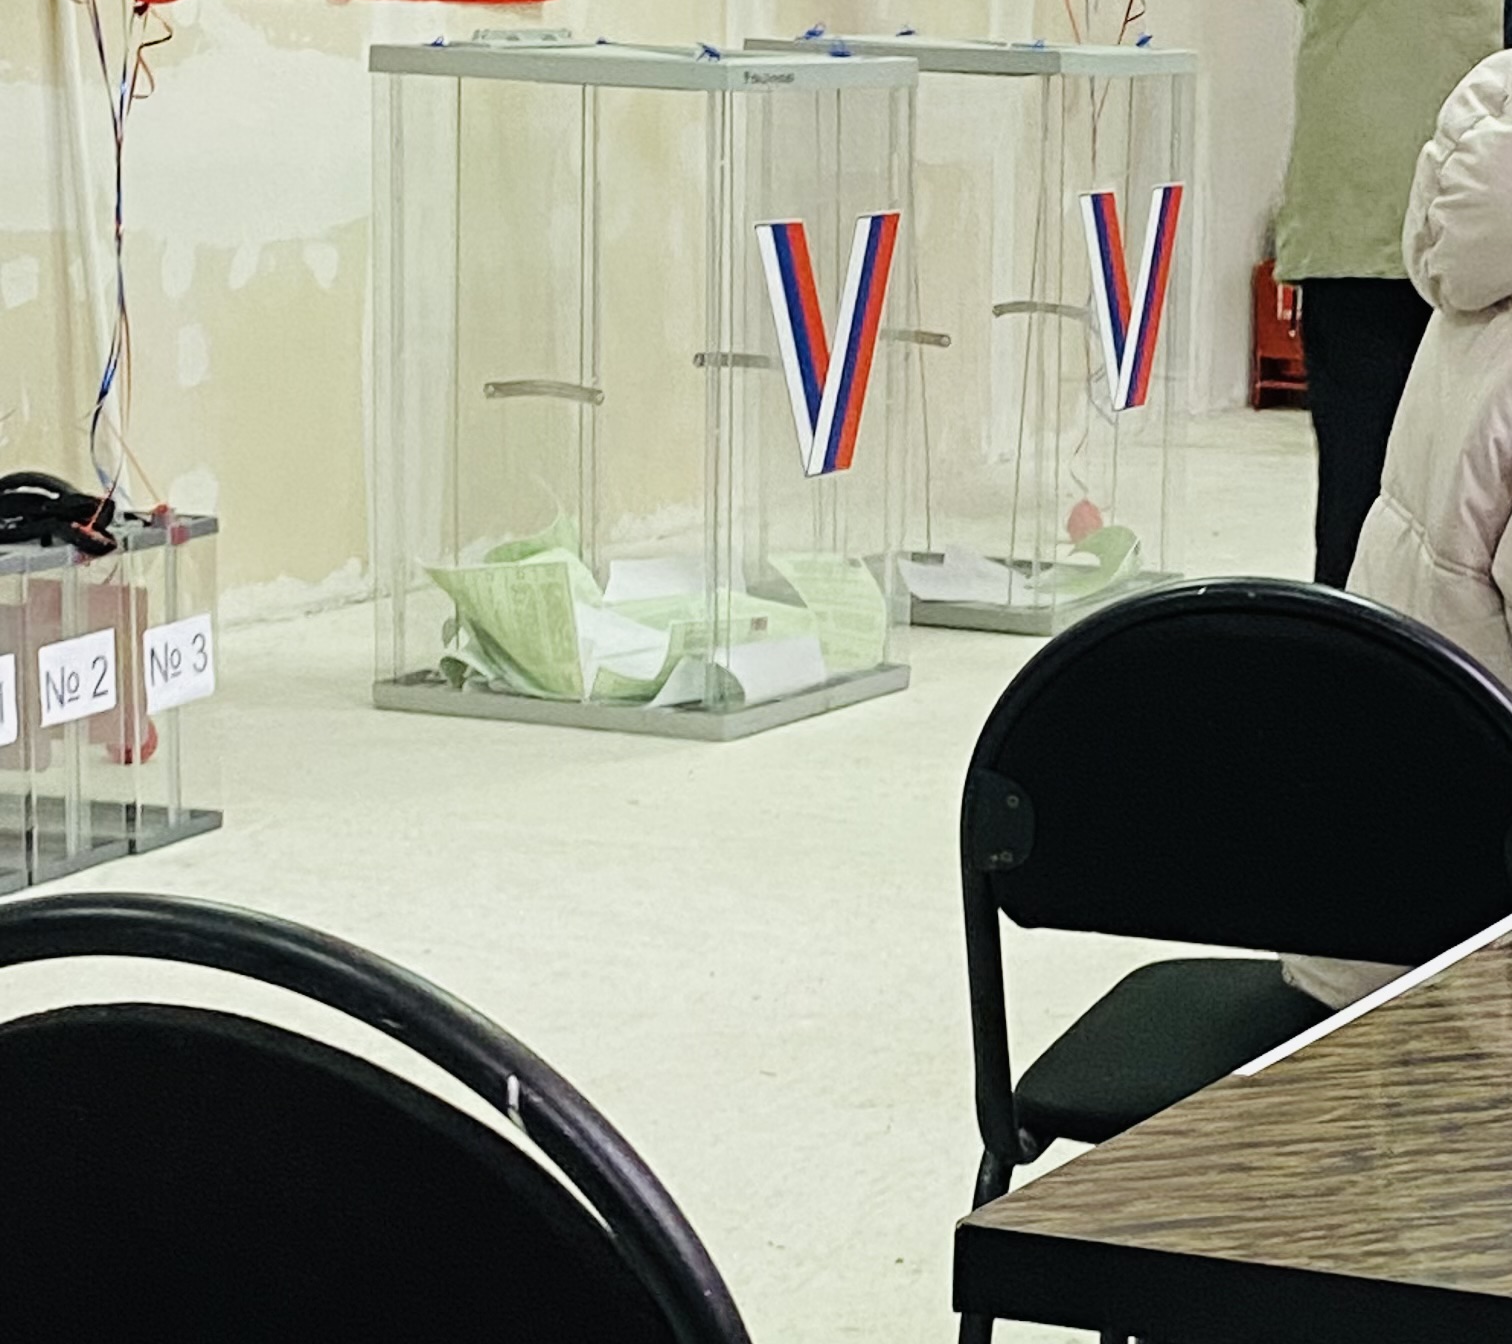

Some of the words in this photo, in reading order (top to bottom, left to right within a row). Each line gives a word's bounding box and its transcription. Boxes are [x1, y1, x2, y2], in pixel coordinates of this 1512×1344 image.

[46, 666, 80, 712] №
[91, 655, 109, 698] 2
[150, 642, 182, 687] №
[191, 632, 208, 673] 3
